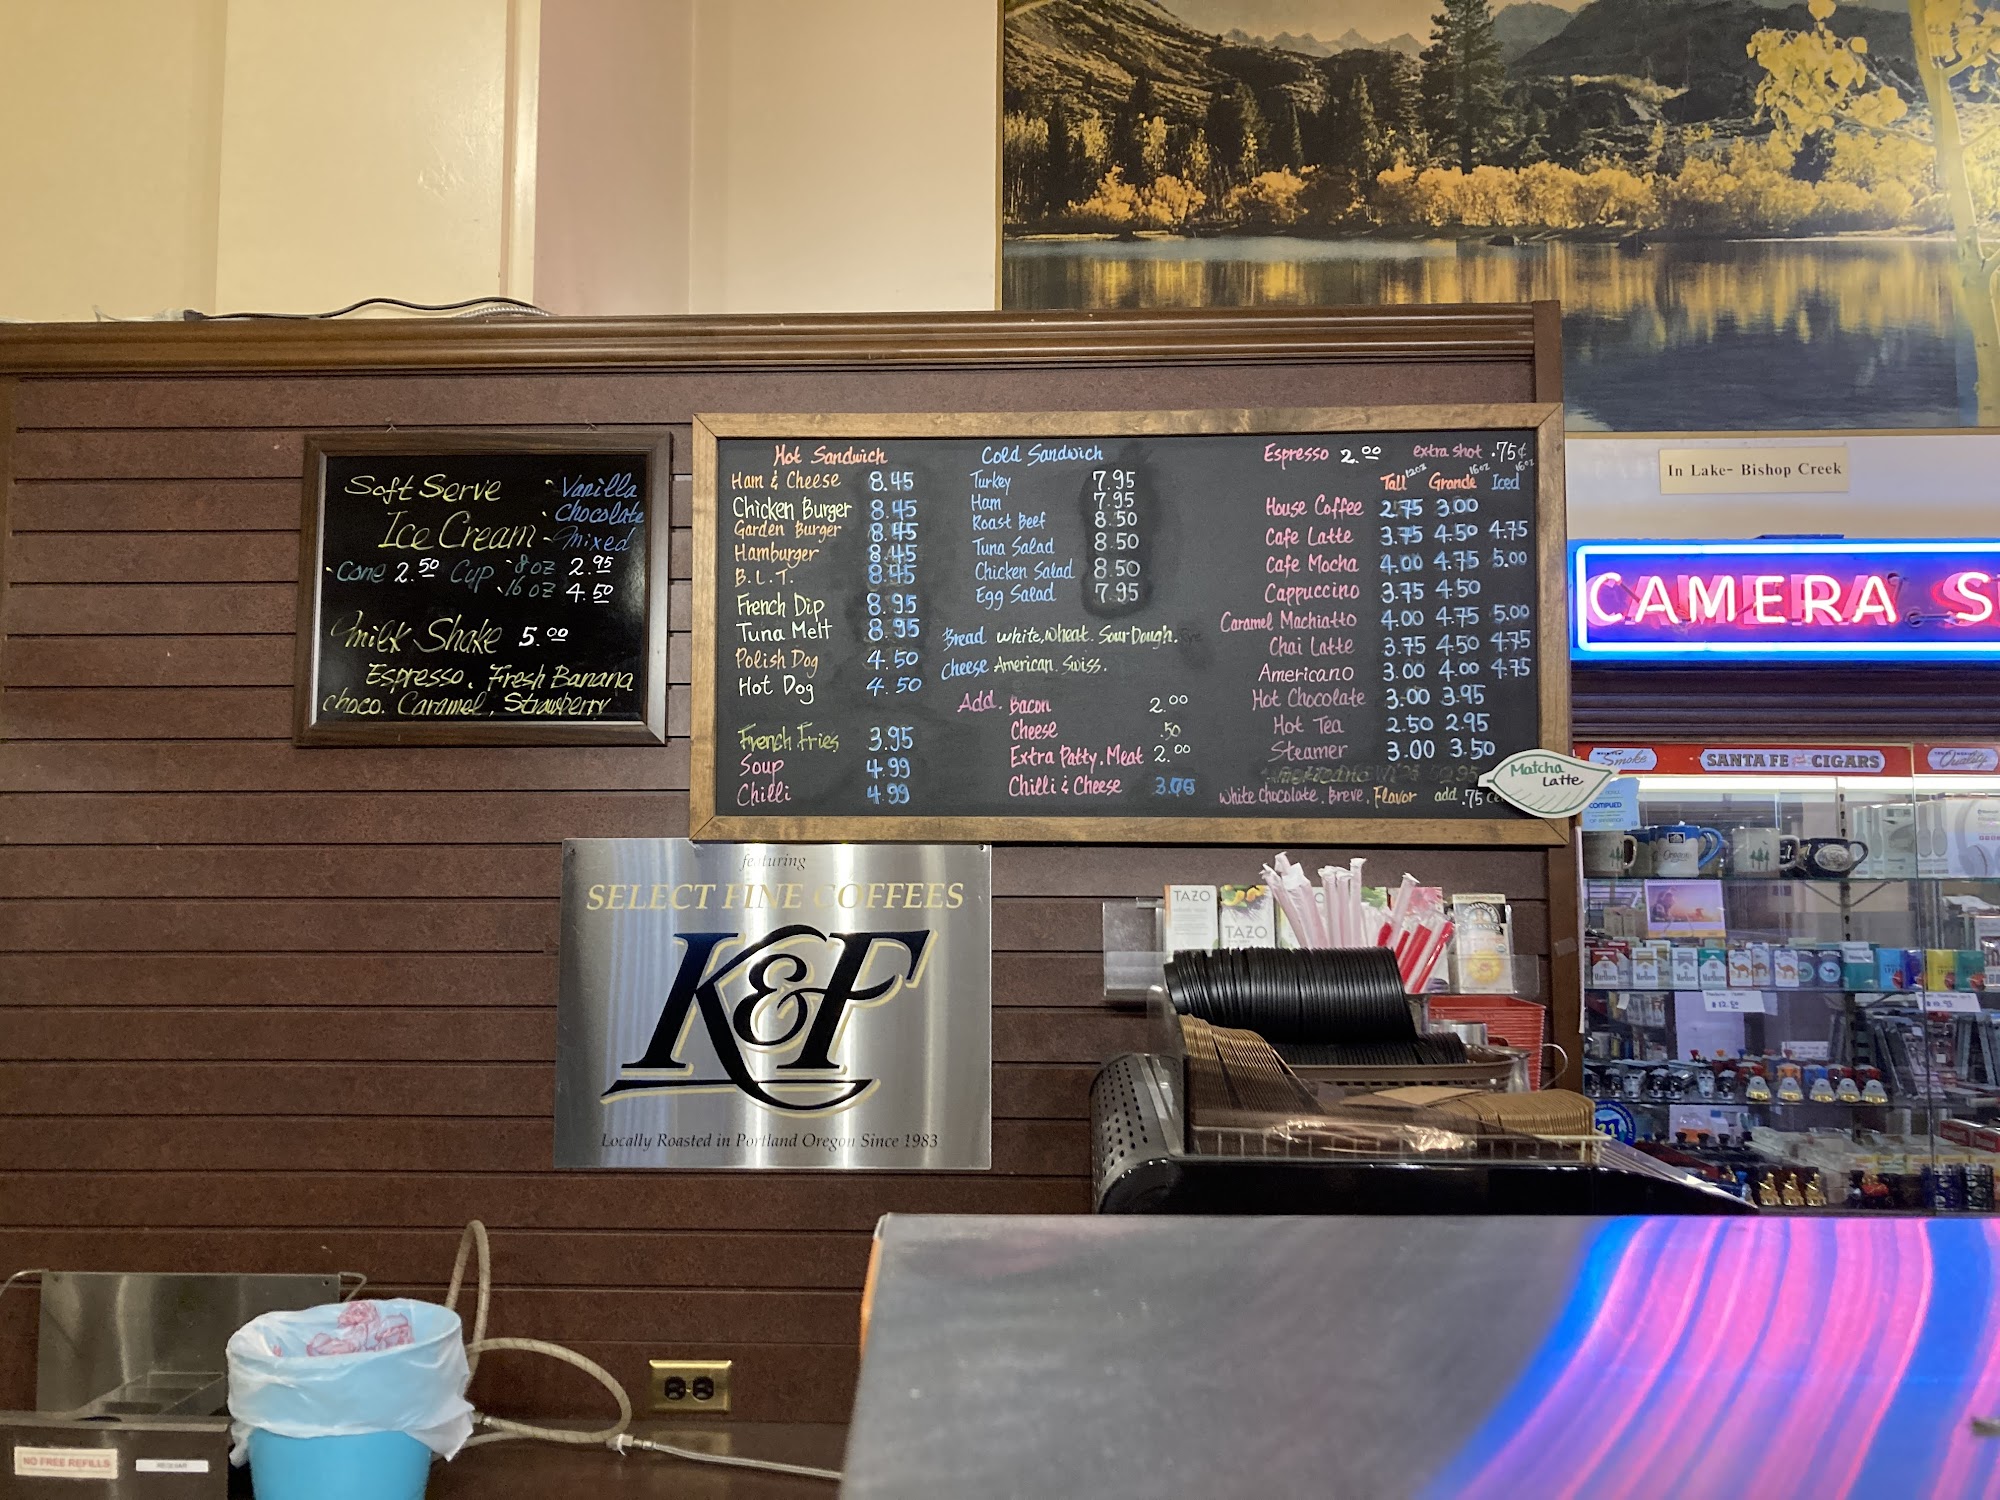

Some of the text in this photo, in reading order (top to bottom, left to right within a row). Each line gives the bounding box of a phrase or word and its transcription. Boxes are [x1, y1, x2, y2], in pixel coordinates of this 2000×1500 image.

[774, 444, 888, 466] Hot Sandwich
[982, 444, 1103, 466] Cold Sandwich
[1264, 443, 1329, 470] Espresso
[1413, 443, 1482, 458] extra shot
[732, 470, 914, 491] Ham & Cheese 8.45
[1380, 471, 1520, 491] Tall Grande Iced
[1668, 462, 1842, 478] In Bishop Creek
[345, 474, 501, 505] Soft Serve
[561, 473, 638, 499] Vanilla
[970, 470, 1136, 495] Turkey 7.95
[733, 496, 917, 522] Chicken Burger 8.45
[971, 492, 1135, 511] Ham 7.95
[1266, 494, 1478, 520] House Coffee 2.75 3.00
[378, 511, 536, 551] Ice Cream
[734, 520, 918, 543] Garden Burger 8.45
[972, 511, 1137, 530] Roast Beef 8.50
[972, 532, 1139, 555] Tuna Salad 8.50
[1266, 520, 1528, 548] Cafe Latte 3.75 4.50 4.75
[735, 542, 917, 568] Hamburger 8.45
[1266, 548, 1527, 578] Cafe Mocha 4.00 4.75 5.00
[451, 560, 494, 593] Cup
[975, 558, 1140, 580] Chicken Salad 8.50
[976, 582, 1139, 610] Egg Salad 7.95
[1265, 578, 1480, 606] Cappuccino 3.75 4.50
[1586, 572, 1897, 627] CAMERA
[737, 592, 916, 622] French Dip 8.95
[1220, 604, 1530, 632] Caramel Machiatto 4.00 4.75 5.00
[413, 614, 502, 654] Shake
[736, 618, 919, 642] Tuna Melt 8.95
[942, 626, 987, 651] Bread
[1270, 630, 1531, 657] Chai Latte 3.75 4.50 4.75
[736, 648, 918, 678] Polish Dog 4.50
[1258, 658, 1531, 682] Americano 3.00 4.00 4.75
[488, 664, 634, 691] Fresh Banana
[739, 675, 921, 704] Hot Dog 4.50
[504, 692, 611, 716] Strawberry
[1009, 695, 1051, 715] Bacon
[1252, 685, 1485, 711] Hot Chocolate 3.00 3.95
[1011, 719, 1058, 740] Cheese
[1274, 713, 1490, 735] Hot Tea 2.50 2.95
[738, 722, 913, 752] French Fries 3.95
[1010, 744, 1144, 768] Extra Meat
[1268, 738, 1495, 762] Steamer 3.00 3.50
[1601, 749, 1647, 766] Smoke
[1707, 754, 1879, 768] SANTA FE CIGARS
[1940, 750, 1988, 768] Quality
[740, 753, 910, 783] Soup 4.99
[1510, 762, 1564, 776] Matcha
[1009, 775, 1122, 797] Chilli Cheese
[1543, 775, 1583, 786] Latte
[737, 781, 910, 806] Chilli 4.99
[1373, 786, 1483, 808] Flavor add .75
[739, 854, 806, 871] featuring
[586, 882, 964, 910] SELECT FINE COFFEES
[1174, 891, 1210, 901] TAZO
[1225, 926, 1267, 938] TAZO
[600, 924, 937, 1119] K&F
[601, 1132, 937, 1152] Locally Roasted in Portland Oregon Since 1983
[23, 1457, 110, 1468] NO FREE REFILLS
